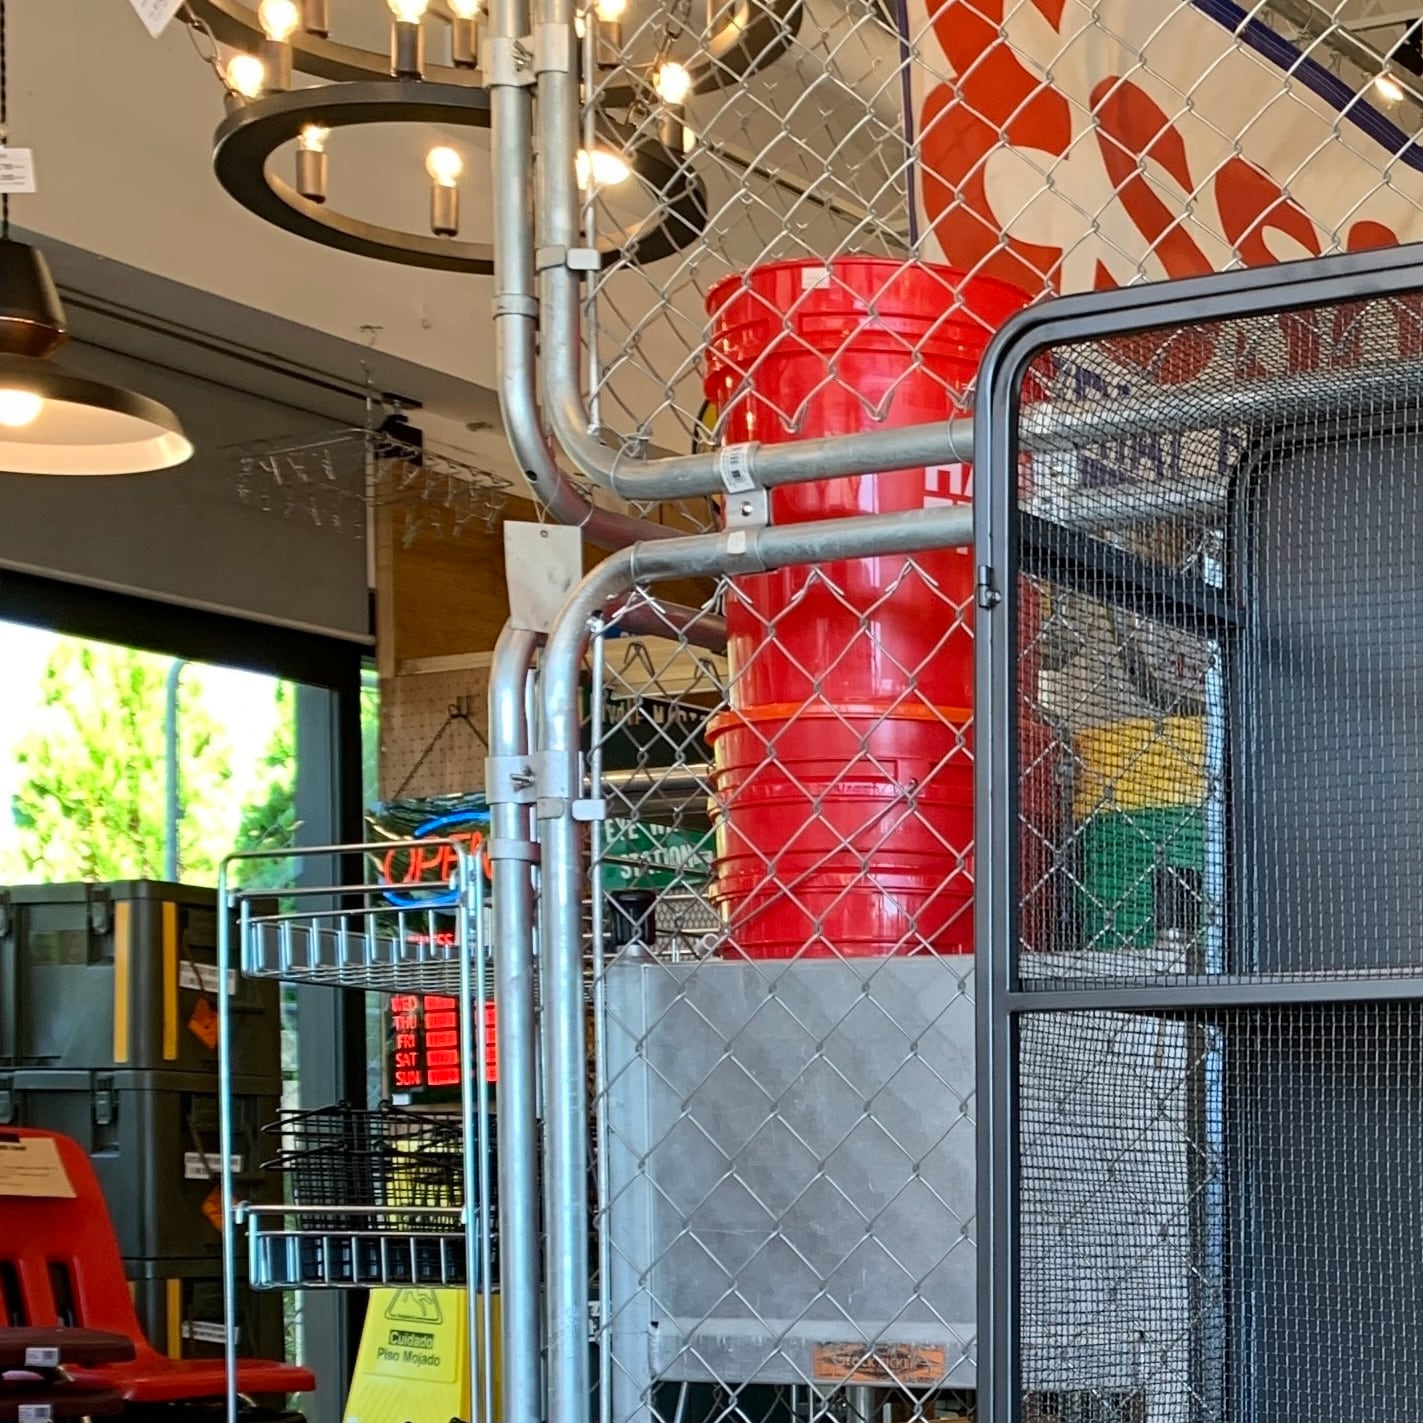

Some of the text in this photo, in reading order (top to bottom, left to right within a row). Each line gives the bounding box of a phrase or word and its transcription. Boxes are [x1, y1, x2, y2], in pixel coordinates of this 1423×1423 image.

[603, 816, 640, 843] EYE
[391, 994, 418, 1013] WED
[391, 1014, 418, 1031] THU
[396, 1033, 416, 1049] FRI
[395, 1051, 420, 1068] SAT
[395, 1070, 421, 1086] SUN
[390, 1331, 434, 1348] Cuidado
[377, 1347, 441, 1368] Piso Mojado
